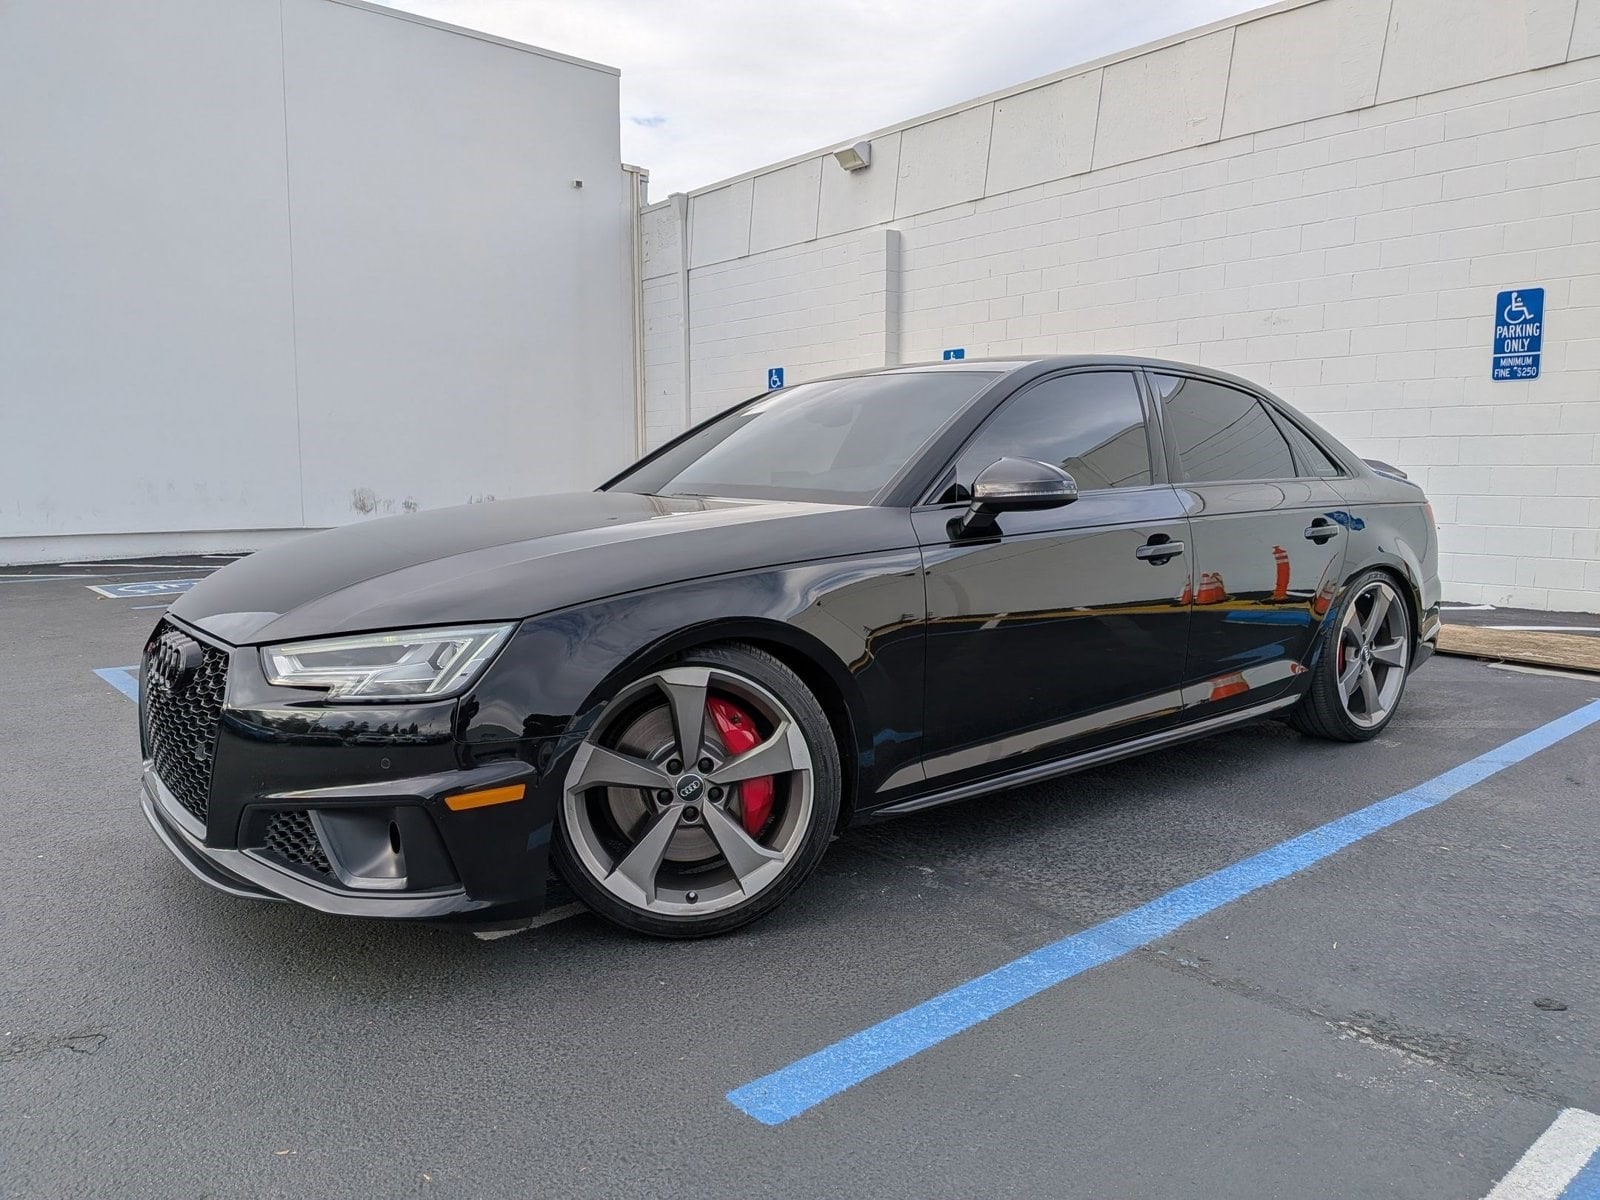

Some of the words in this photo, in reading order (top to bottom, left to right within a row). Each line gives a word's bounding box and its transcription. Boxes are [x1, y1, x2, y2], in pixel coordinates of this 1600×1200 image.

[1496, 323, 1540, 338] PARKING
[1504, 338, 1530, 352] ONLY
[1500, 356, 1533, 367] MINIMUM
[1494, 368, 1510, 378] FINE
